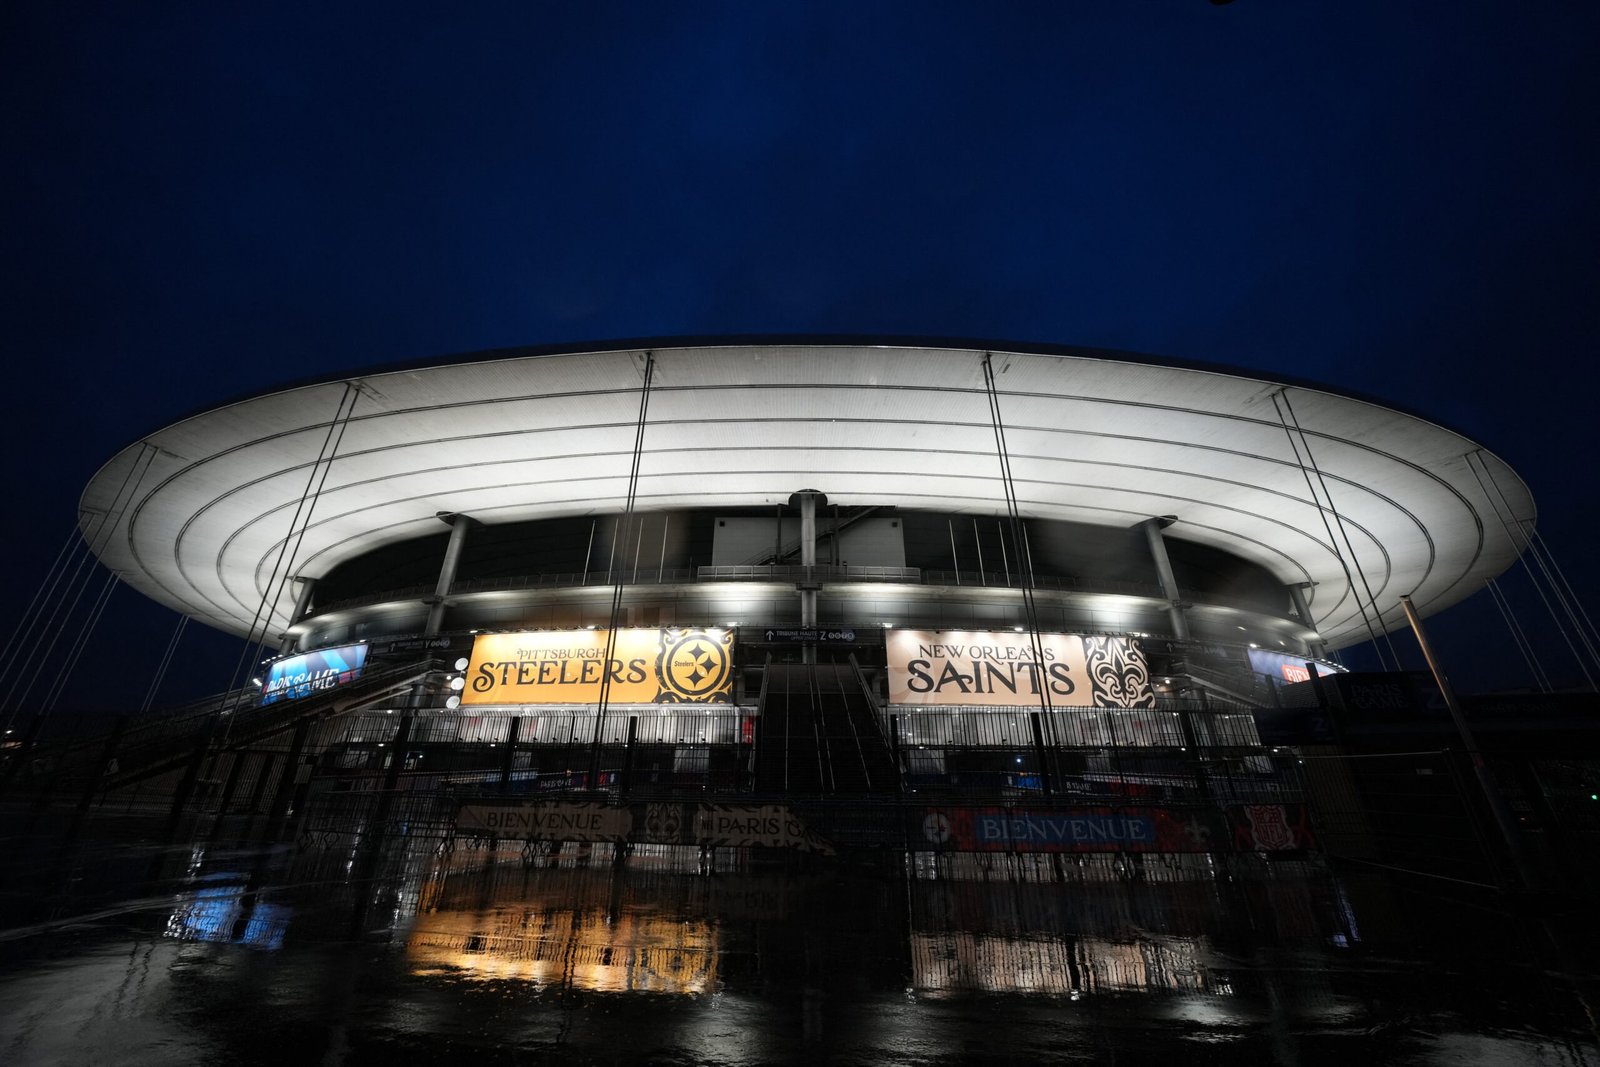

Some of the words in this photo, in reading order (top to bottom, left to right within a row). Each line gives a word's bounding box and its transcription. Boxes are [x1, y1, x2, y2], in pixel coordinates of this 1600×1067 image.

[516, 647, 606, 660] PITTSBURGH
[919, 644, 965, 659] NEW
[969, 644, 1055, 665] ORLEANS
[472, 658, 647, 693] STEELERS
[907, 659, 1076, 695] SAINTS
[487, 812, 603, 830] BIENVENUE
[718, 818, 780, 835] PARIS
[983, 819, 1146, 840] BIENVENUE
